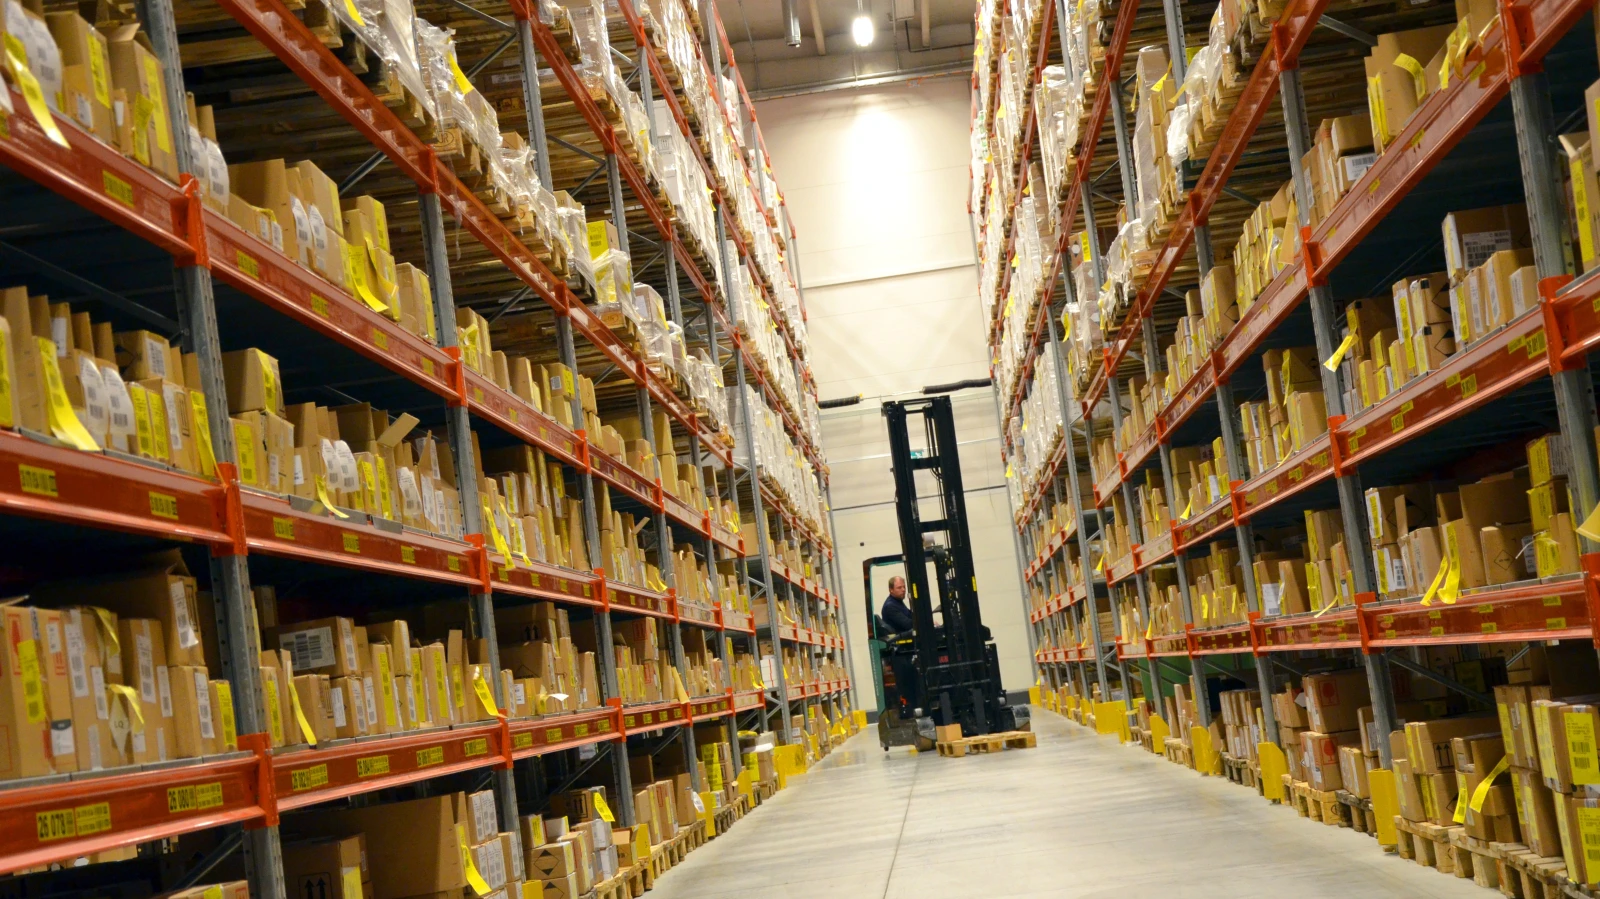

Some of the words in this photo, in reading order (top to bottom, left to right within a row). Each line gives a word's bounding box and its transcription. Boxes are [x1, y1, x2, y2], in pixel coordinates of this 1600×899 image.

[169, 790, 177, 810] 26
[38, 815, 49, 838] 26
[51, 813, 66, 836] 078
